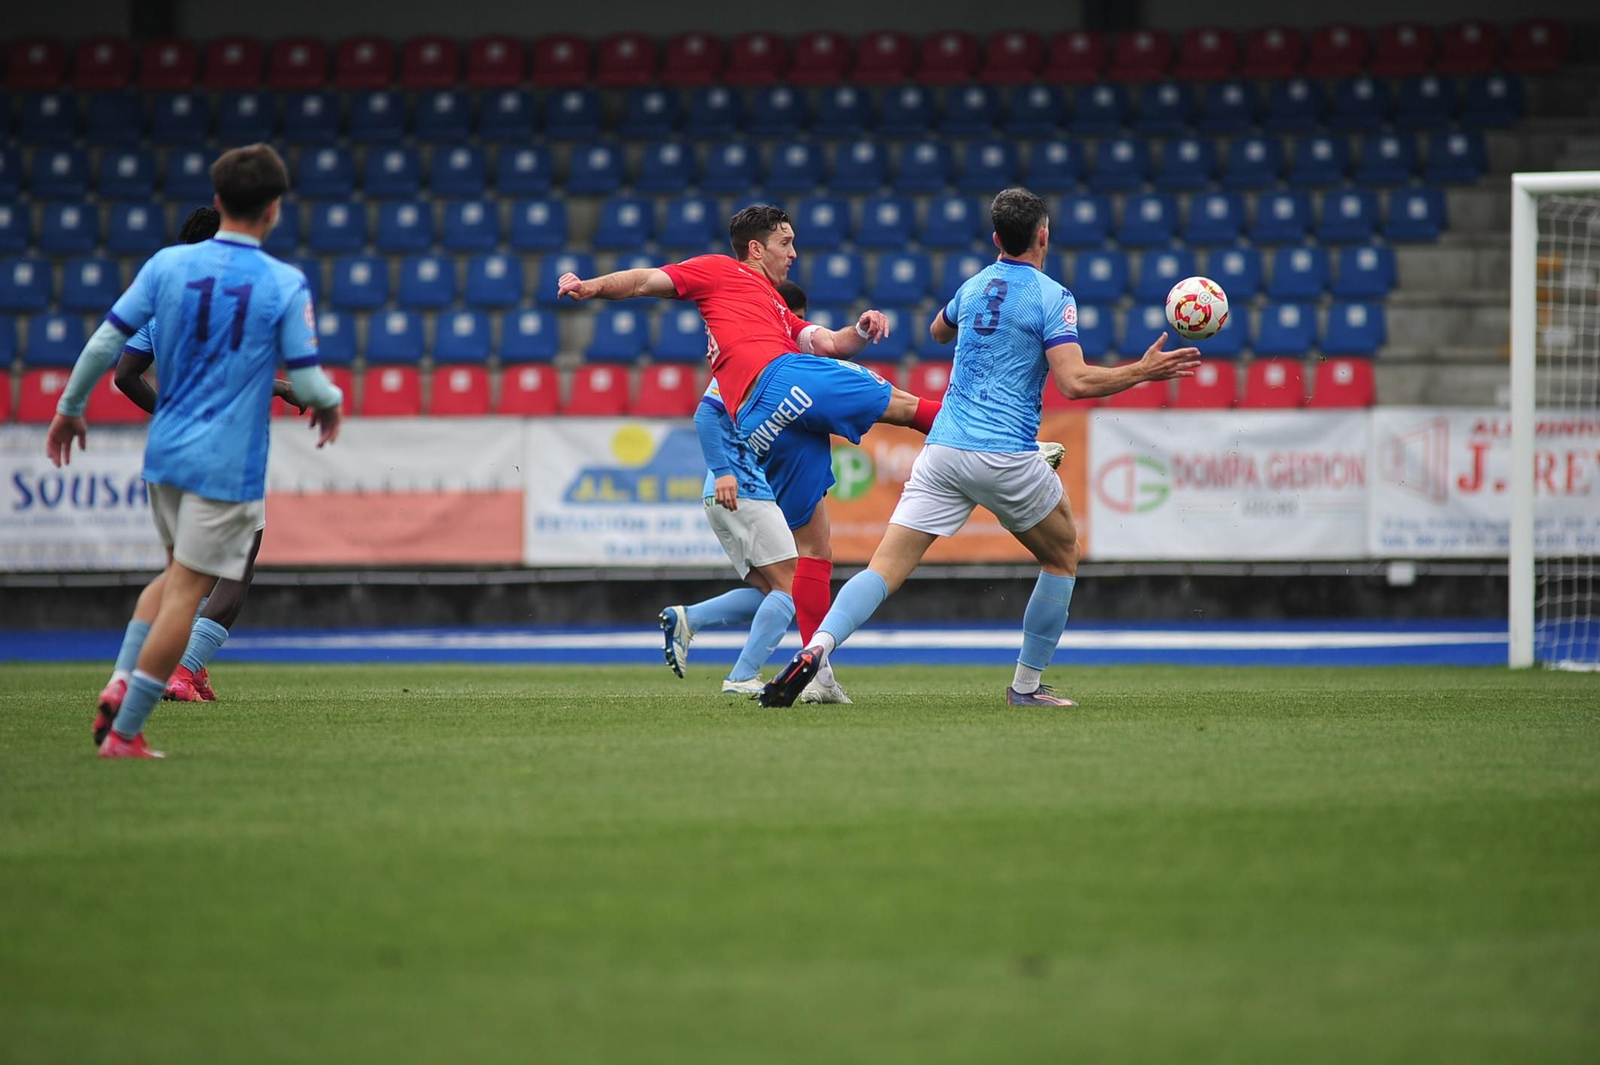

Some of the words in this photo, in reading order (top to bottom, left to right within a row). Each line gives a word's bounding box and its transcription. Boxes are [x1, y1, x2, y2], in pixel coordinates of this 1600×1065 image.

[185, 276, 253, 352] 11
[973, 278, 1008, 336] 3
[747, 385, 814, 458] POVARELO
[11, 469, 149, 511] SOUSA
[1534, 449, 1600, 495] RE
